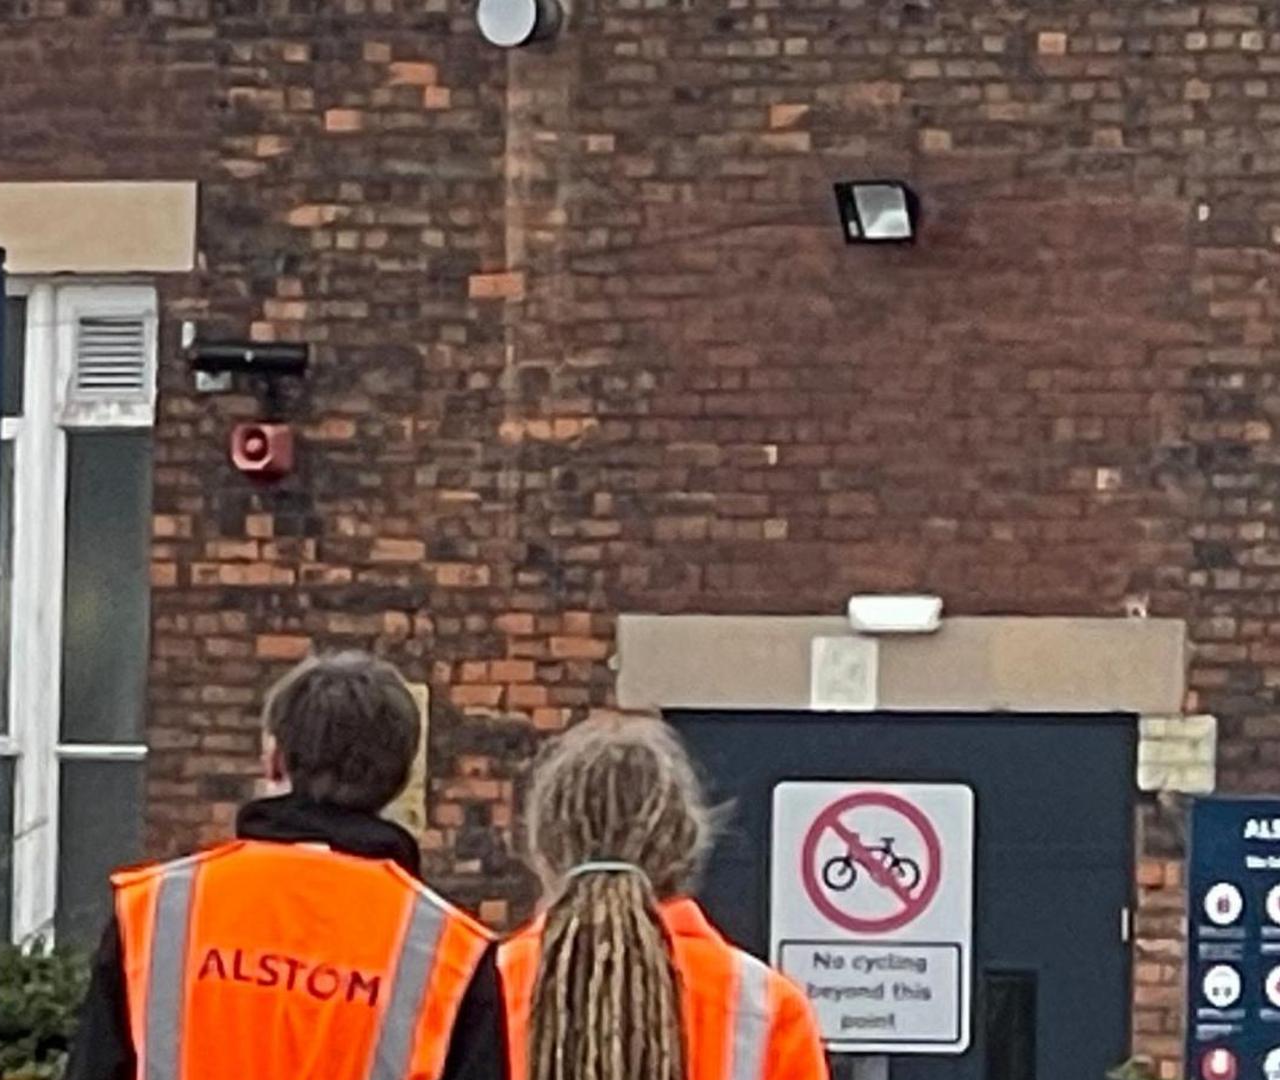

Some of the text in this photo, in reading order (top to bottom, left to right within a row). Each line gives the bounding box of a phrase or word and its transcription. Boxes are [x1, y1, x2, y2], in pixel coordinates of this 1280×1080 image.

[813, 951, 927, 973] No cycling
[198, 948, 381, 1007] ALSTOM
[807, 982, 932, 1002] beyond this
[841, 1013, 895, 1030] point
